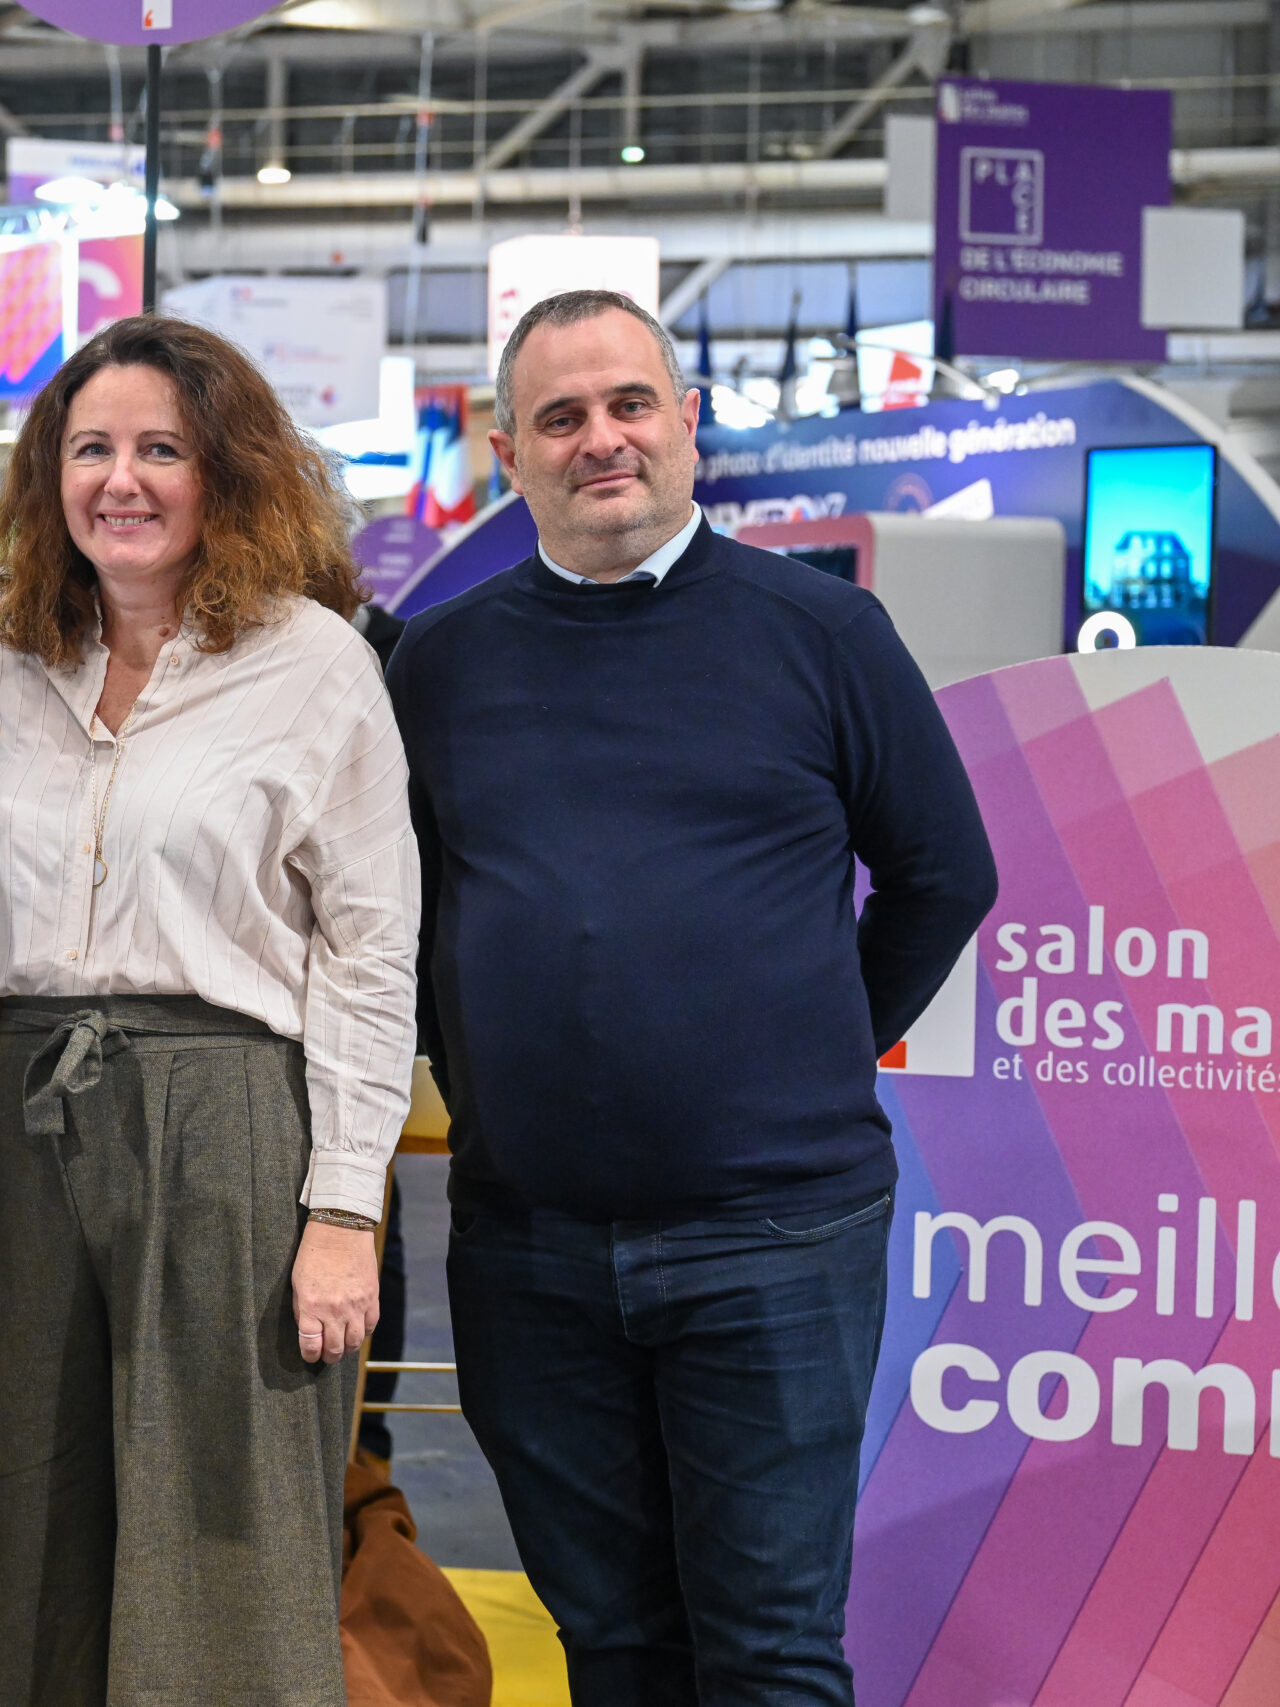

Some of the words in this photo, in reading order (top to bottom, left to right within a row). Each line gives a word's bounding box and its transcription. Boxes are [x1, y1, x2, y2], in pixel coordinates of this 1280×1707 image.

[948, 411, 1077, 464] génération
[995, 905, 1209, 980] salon
[995, 976, 1125, 1050] des
[992, 1053, 1023, 1081] et
[1035, 1050, 1089, 1084] des
[1102, 1054, 1280, 1093] collectivité
[912, 1193, 1280, 1321] meill
[910, 1343, 1280, 1459] com
